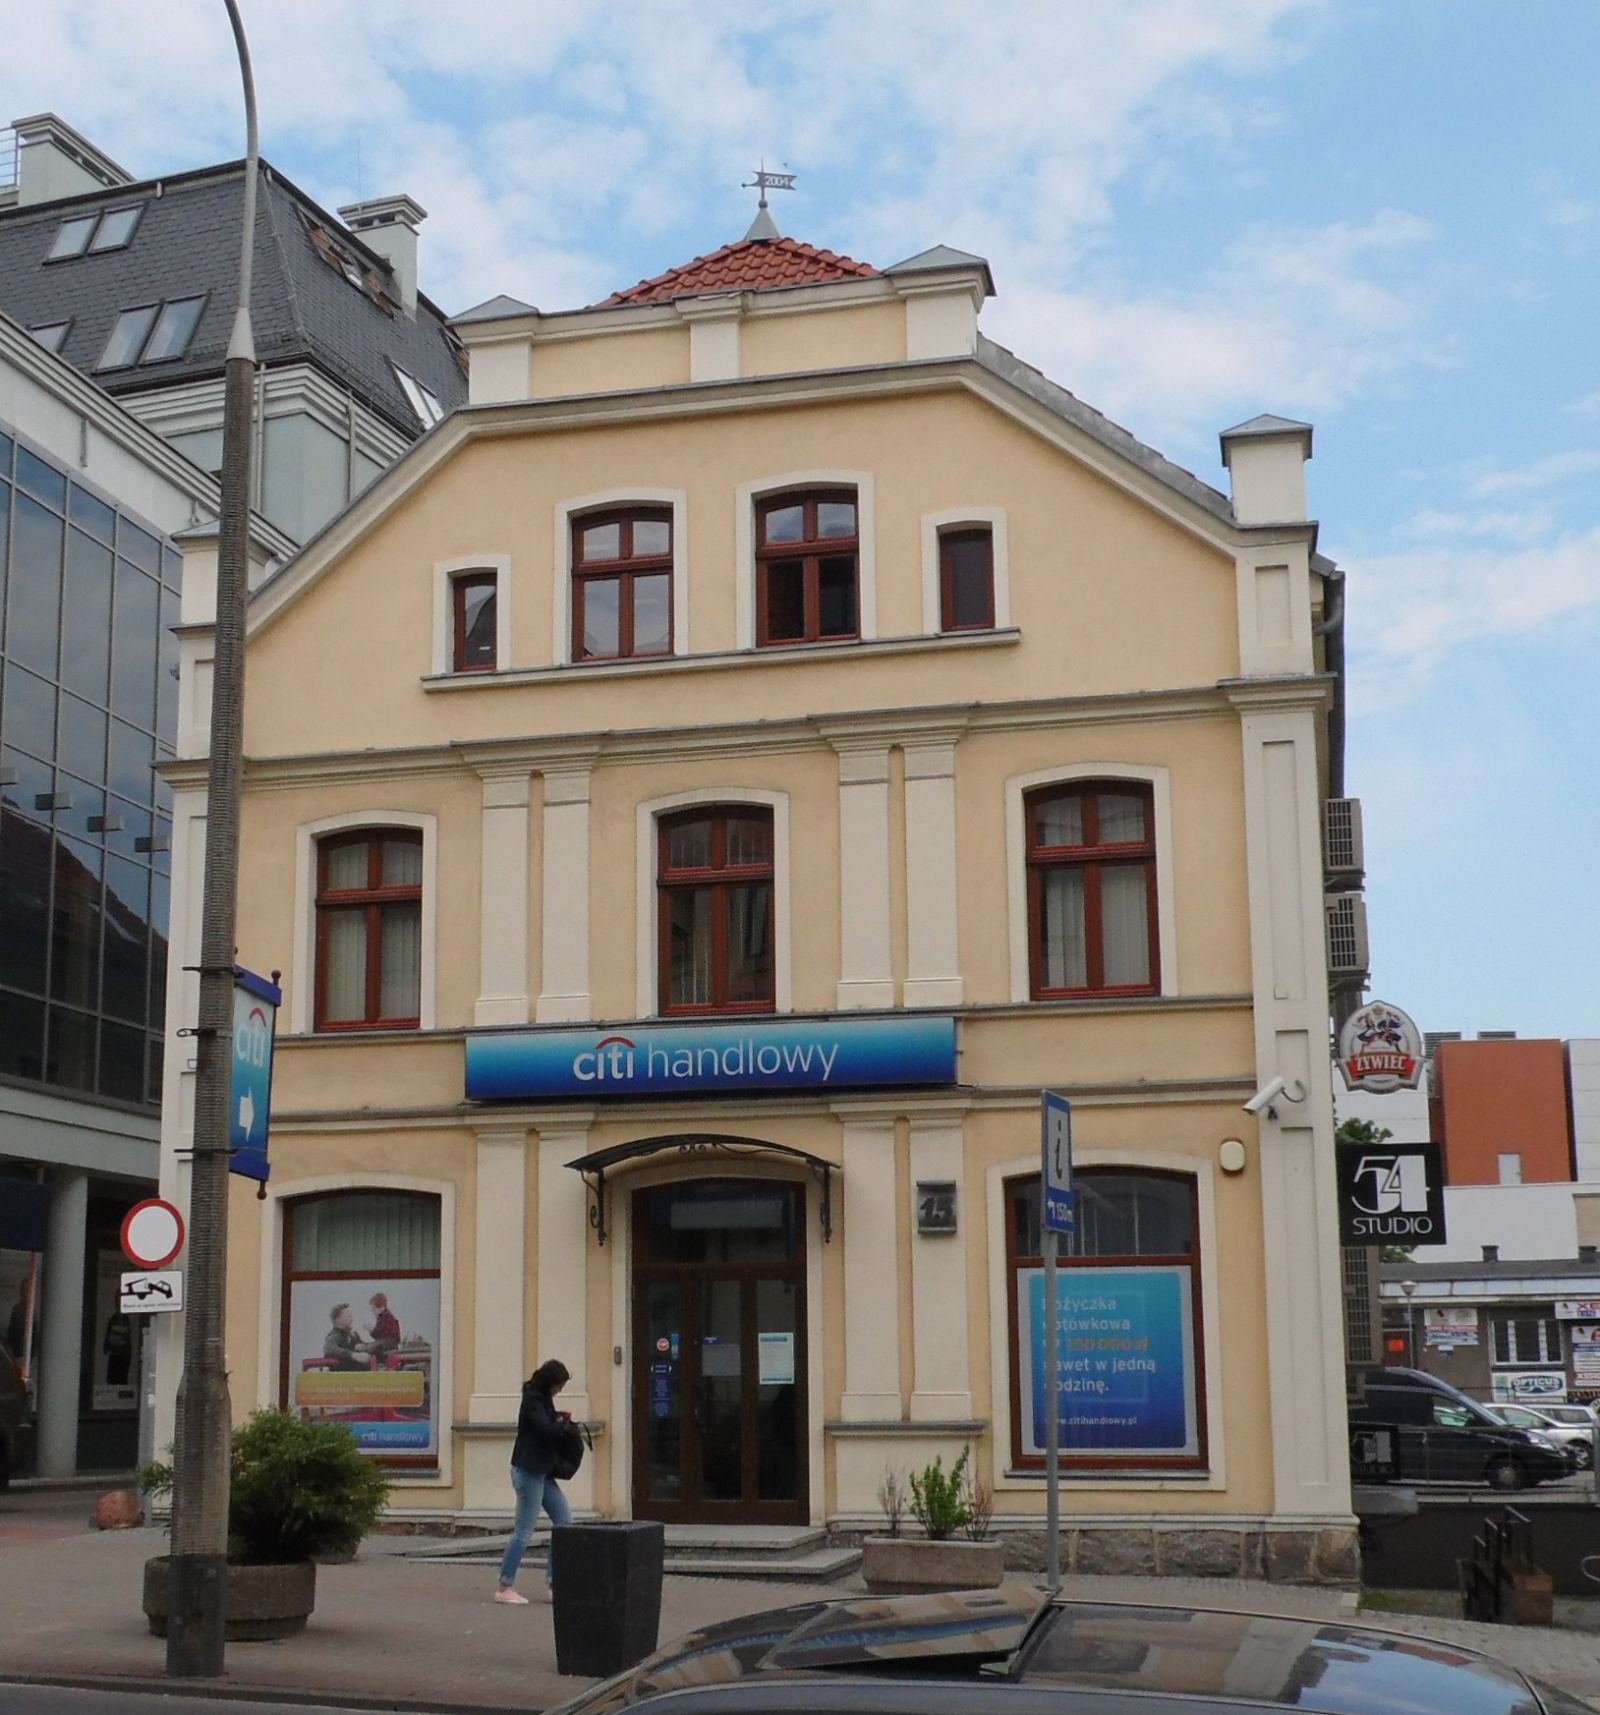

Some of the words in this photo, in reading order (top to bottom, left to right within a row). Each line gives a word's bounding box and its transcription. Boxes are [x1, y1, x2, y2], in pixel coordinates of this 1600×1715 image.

[765, 175, 789, 187] 2004
[572, 1042, 634, 1081] citi
[648, 1041, 839, 1081] handlowy
[1351, 1154, 1430, 1215] 54
[1352, 1216, 1433, 1235] STUDIO
[1042, 1316, 1131, 1331] otówkowa
[1044, 1357, 1091, 1371] awet
[1095, 1359, 1108, 1371] w
[1111, 1357, 1156, 1374] jedną
[1044, 1377, 1110, 1395] odzinę.
[1513, 1377, 1560, 1387] OPTICUS
